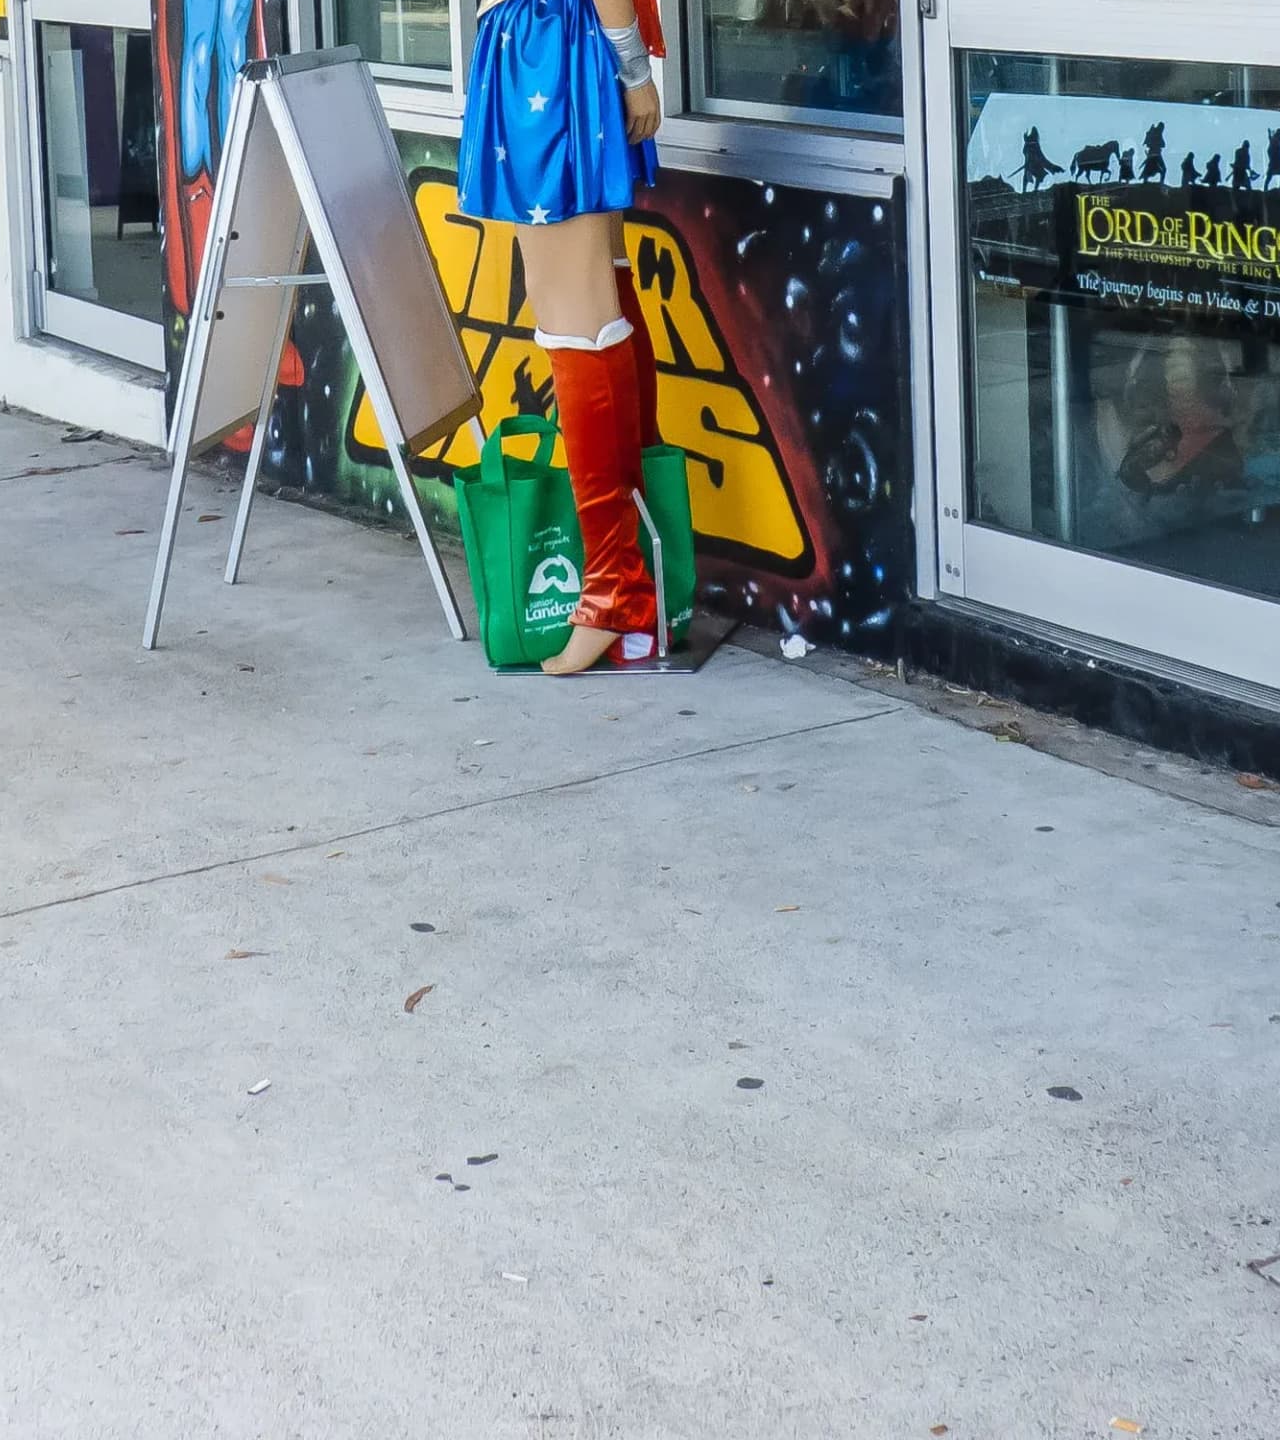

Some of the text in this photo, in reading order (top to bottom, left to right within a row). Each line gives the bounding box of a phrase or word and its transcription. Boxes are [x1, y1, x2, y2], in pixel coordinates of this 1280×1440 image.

[1090, 194, 1110, 207] THE
[1076, 193, 1160, 256] LORD
[1162, 216, 1184, 233] OF
[1159, 230, 1189, 249] THE
[1103, 246, 1272, 280] THE FELLOWSHIP OF THE RING
[1076, 273, 1099, 291] The
[1099, 278, 1144, 303] journey
[1147, 282, 1184, 307] begins
[1187, 293, 1203, 306] on
[1206, 291, 1241, 311] Video
[1245, 300, 1259, 315] &
[525, 601, 580, 623] Landca
